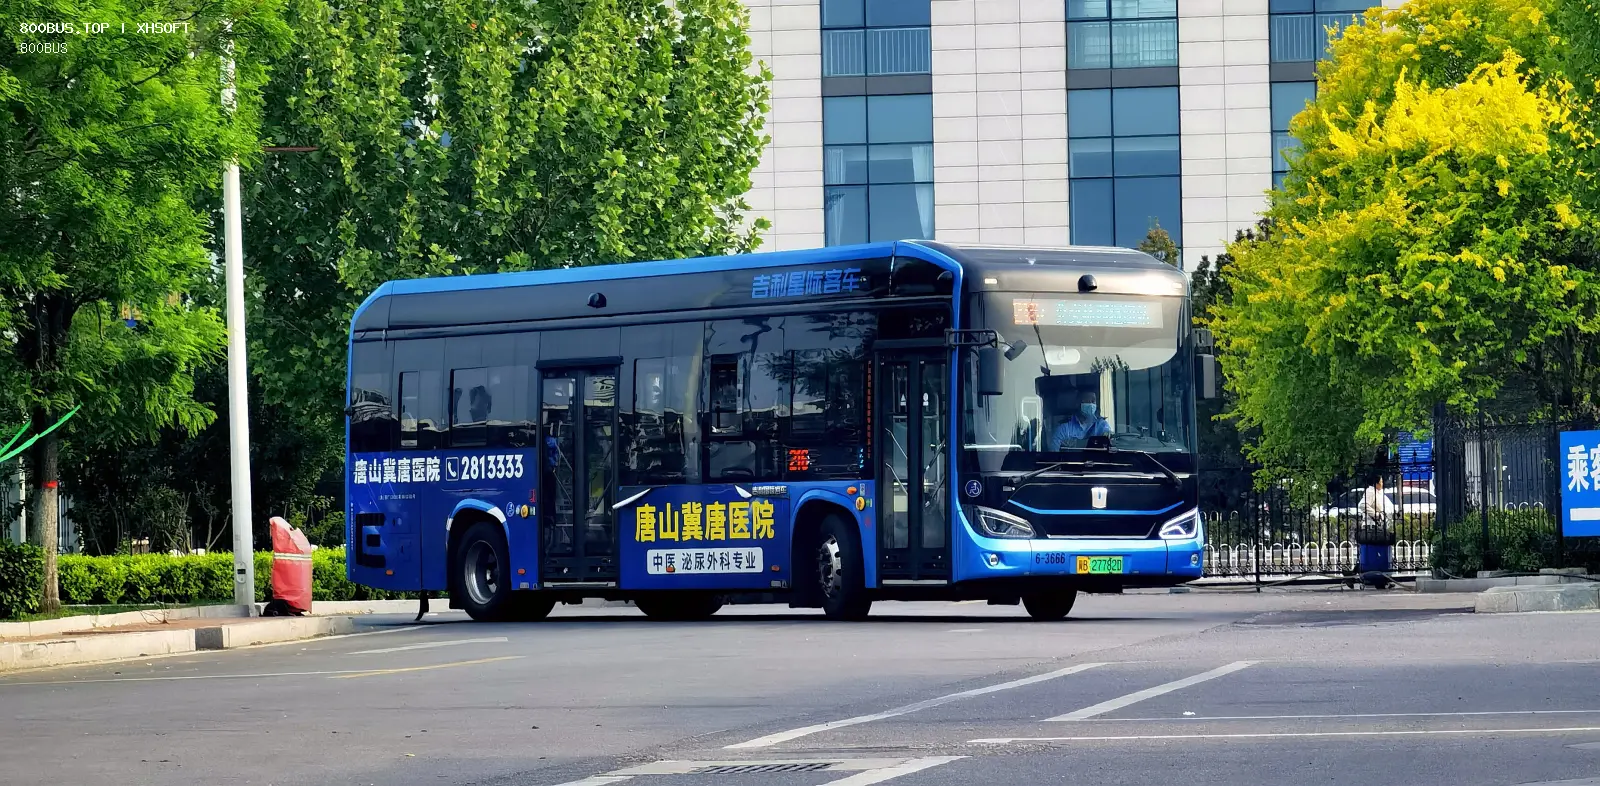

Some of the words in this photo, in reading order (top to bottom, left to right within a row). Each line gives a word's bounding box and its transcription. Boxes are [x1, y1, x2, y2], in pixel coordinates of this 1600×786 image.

[751, 267, 861, 299] 吉利星际客车
[353, 456, 441, 484] 唐山冀唐医院
[461, 454, 524, 480] 2813333
[635, 499, 775, 542] 唐山冀唐医院
[681, 551, 756, 571] 泌尿外科专业
[1035, 552, 1066, 564] 6-3666
